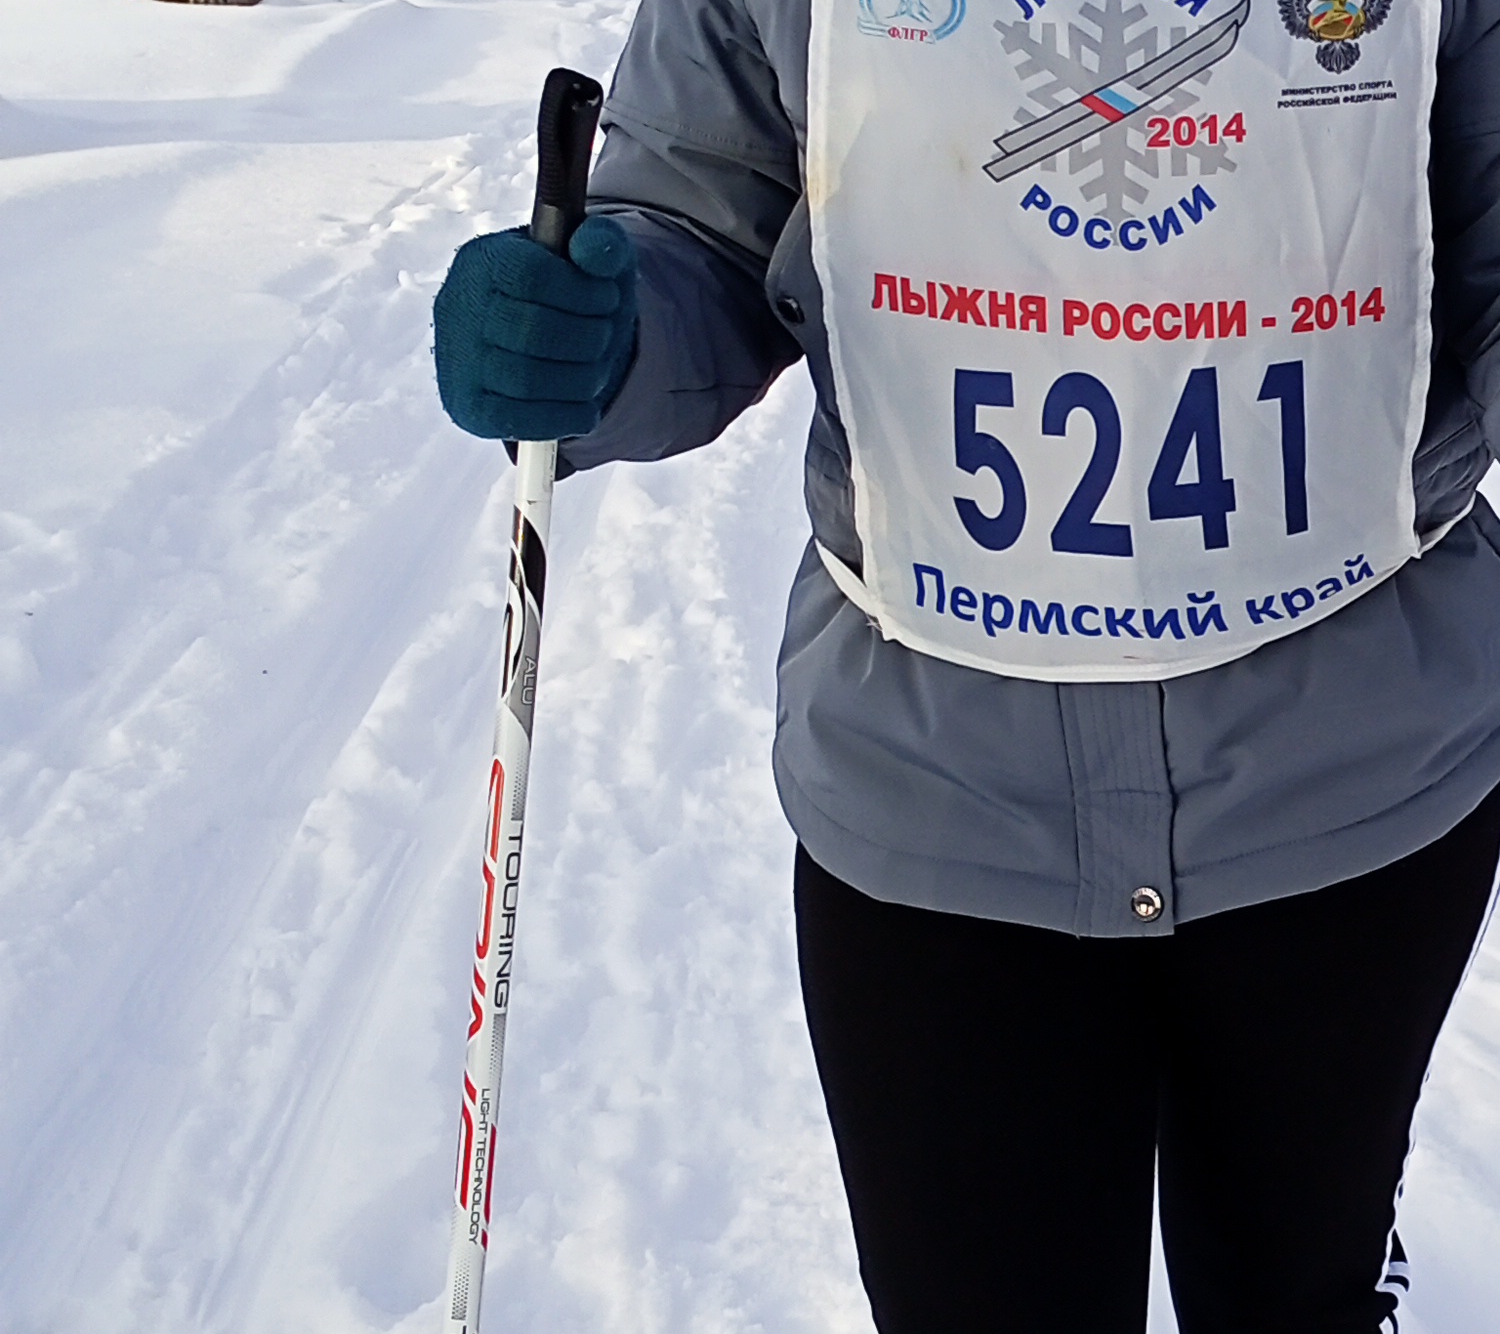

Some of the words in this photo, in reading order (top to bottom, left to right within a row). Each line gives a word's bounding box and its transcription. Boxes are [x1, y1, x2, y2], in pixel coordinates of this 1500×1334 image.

[887, 26, 929, 42] ФЛГР
[1277, 95, 1341, 109] РОССИЙСКОЙ
[1342, 92, 1397, 104] ФЕДЕРАЦИИ
[1281, 83, 1357, 96] МИНИСТЕРСТВО
[1358, 79, 1394, 91] СПОРТА
[1146, 112, 1247, 148] 2014
[1020, 184, 1217, 251] РОССИИ
[872, 272, 1048, 335] ЛЫЖНЯ
[1063, 299, 1247, 342] РОССИИ
[1261, 317, 1277, 328] -
[1292, 286, 1387, 334] 2014
[953, 359, 1309, 558] 5241
[913, 562, 1228, 641] Пермский
[1246, 553, 1375, 625] край
[520, 655, 538, 705] ALU
[493, 820, 523, 1009] TOURING
[477, 1088, 491, 1134] LIGHT
[468, 1137, 486, 1245] TECHNOLOGY
